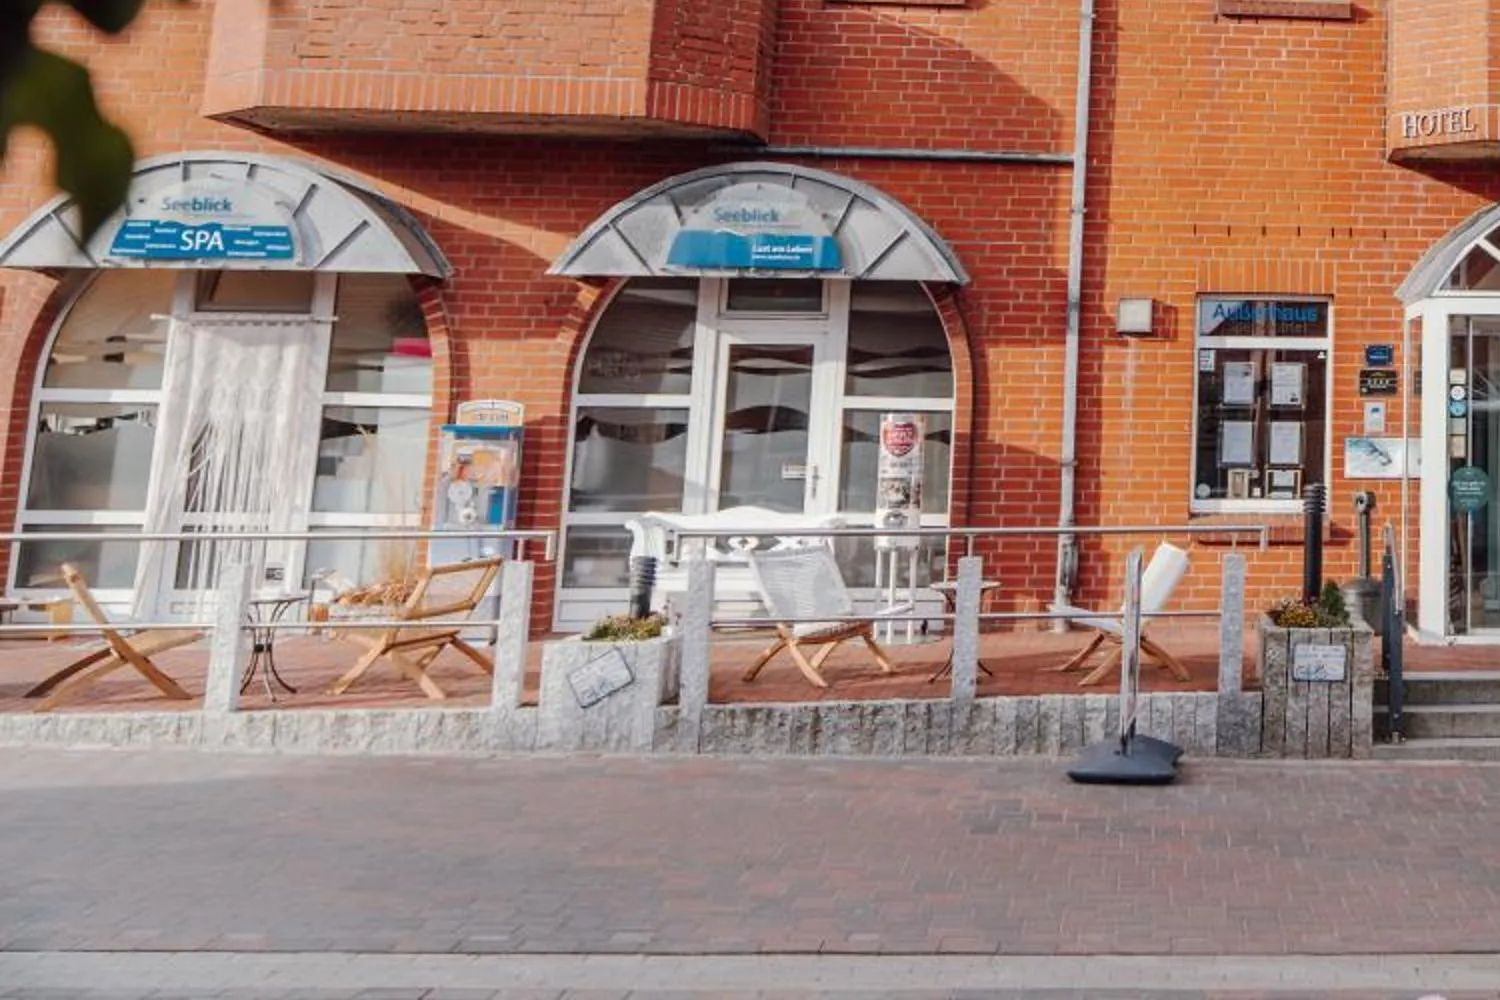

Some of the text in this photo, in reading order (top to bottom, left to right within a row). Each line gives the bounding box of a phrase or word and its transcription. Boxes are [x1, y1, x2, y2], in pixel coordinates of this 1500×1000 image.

[1403, 107, 1477, 138] HOTEL
[161, 197, 233, 213] Seeblick
[714, 207, 780, 223] Seeblick
[180, 229, 224, 251] SPA
